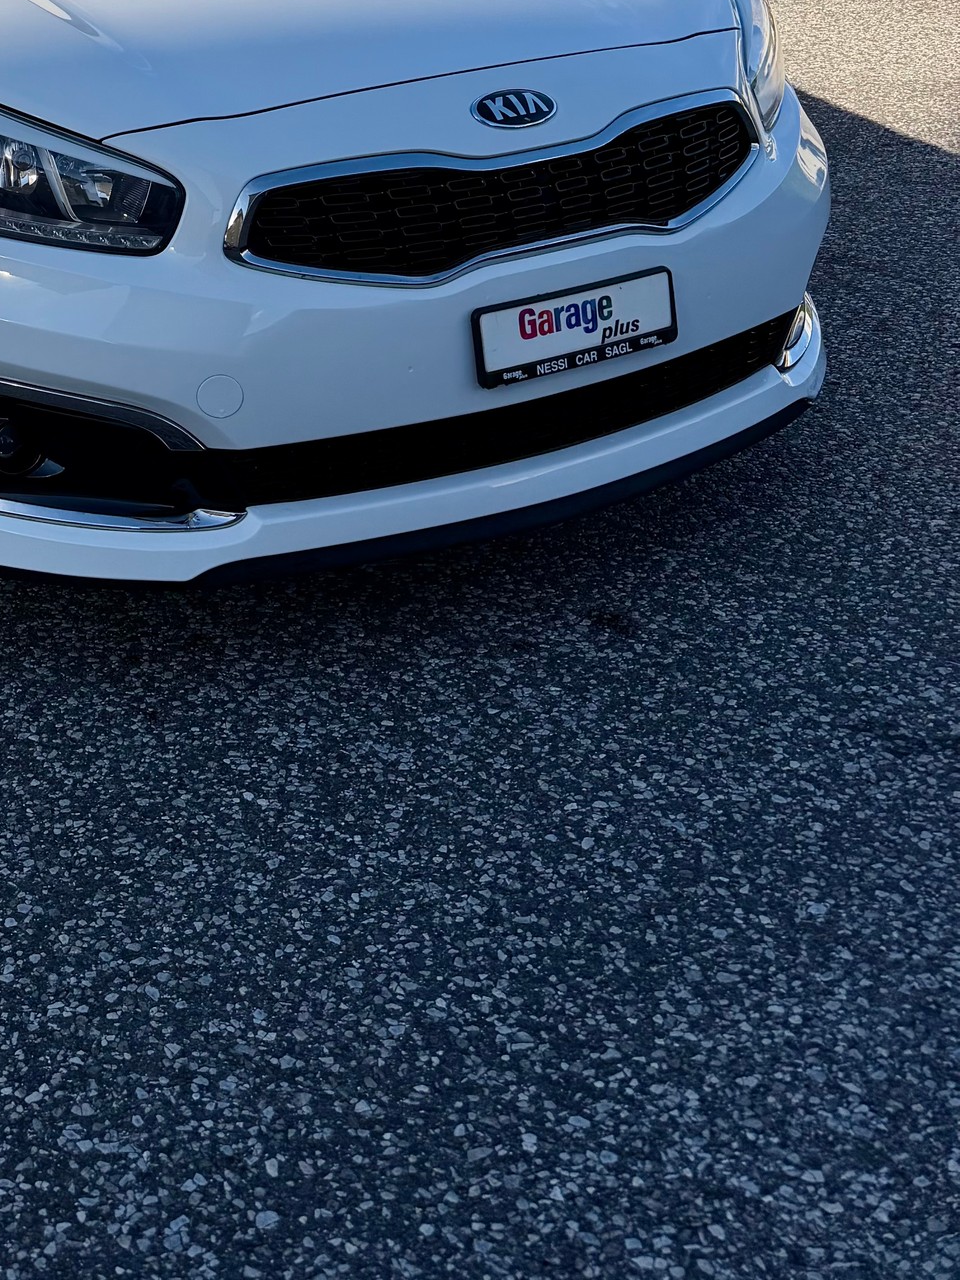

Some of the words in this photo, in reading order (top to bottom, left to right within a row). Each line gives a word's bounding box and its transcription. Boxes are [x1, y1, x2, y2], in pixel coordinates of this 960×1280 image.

[482, 91, 549, 121] KIA
[518, 295, 613, 340] Garage
[601, 318, 640, 344] plus
[536, 358, 568, 376] NESSI
[575, 351, 598, 366] CAR
[605, 342, 633, 358] SAGL
